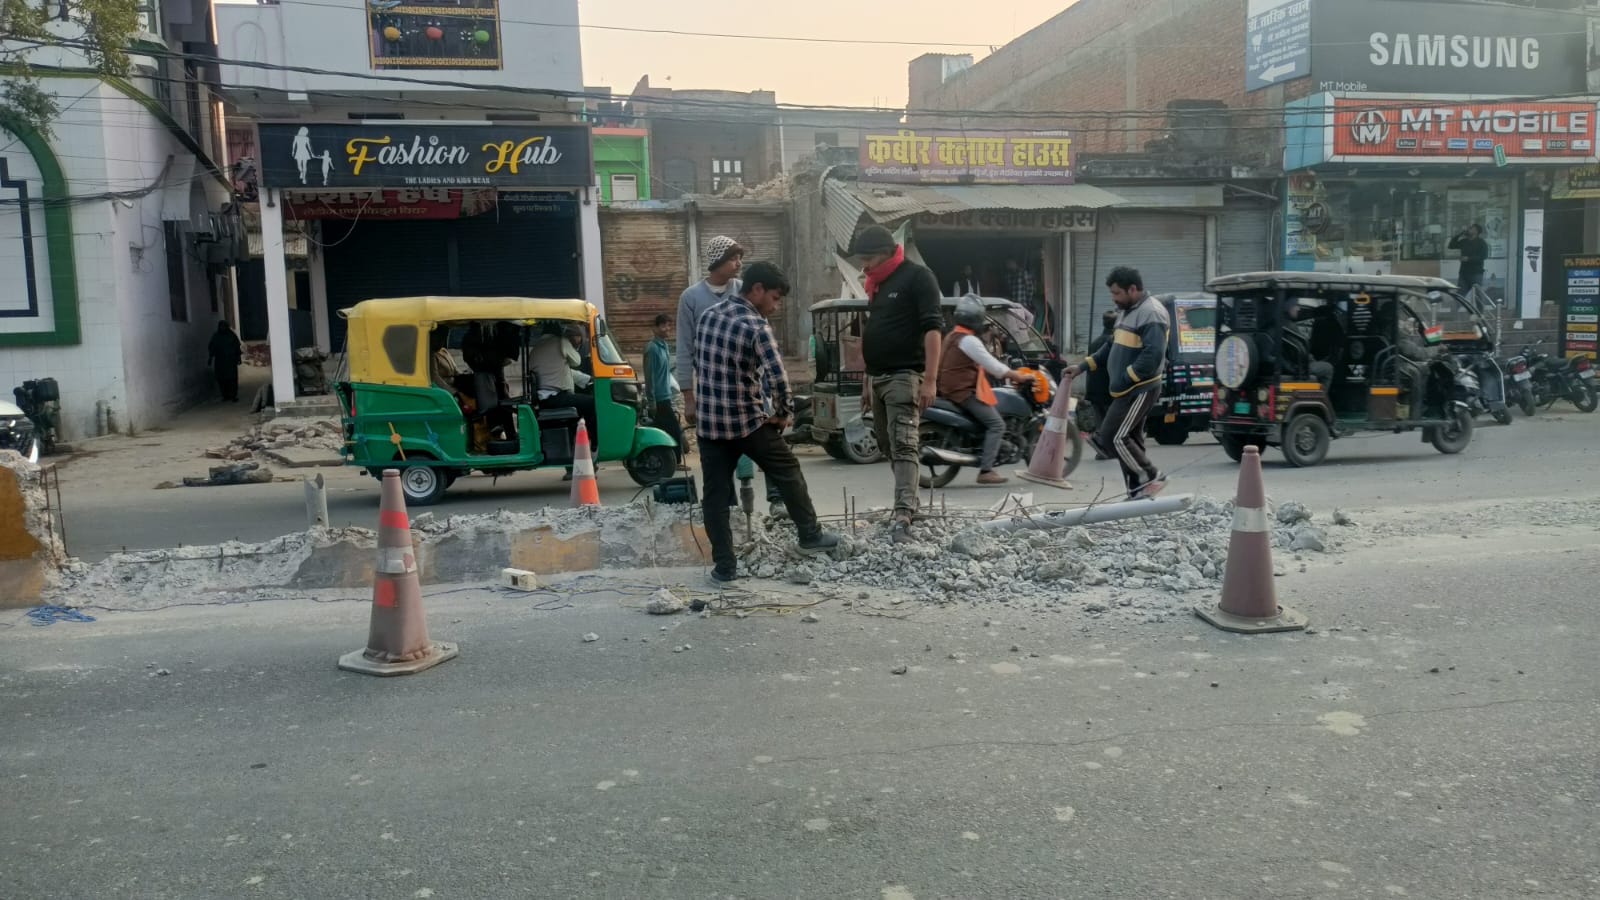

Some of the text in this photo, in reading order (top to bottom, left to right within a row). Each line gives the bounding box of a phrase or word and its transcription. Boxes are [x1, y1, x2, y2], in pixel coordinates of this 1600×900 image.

[1369, 32, 1540, 70] SAMSUNG
[1320, 81, 1367, 91] MT Mobile
[1401, 108, 1589, 133] MT MOBILE
[346, 135, 562, 176] Fashion Hub
[865, 129, 932, 164] कबीर
[1010, 138, 1072, 166] हाउस
[419, 176, 441, 184] LADIES
[443, 176, 455, 184] AND
